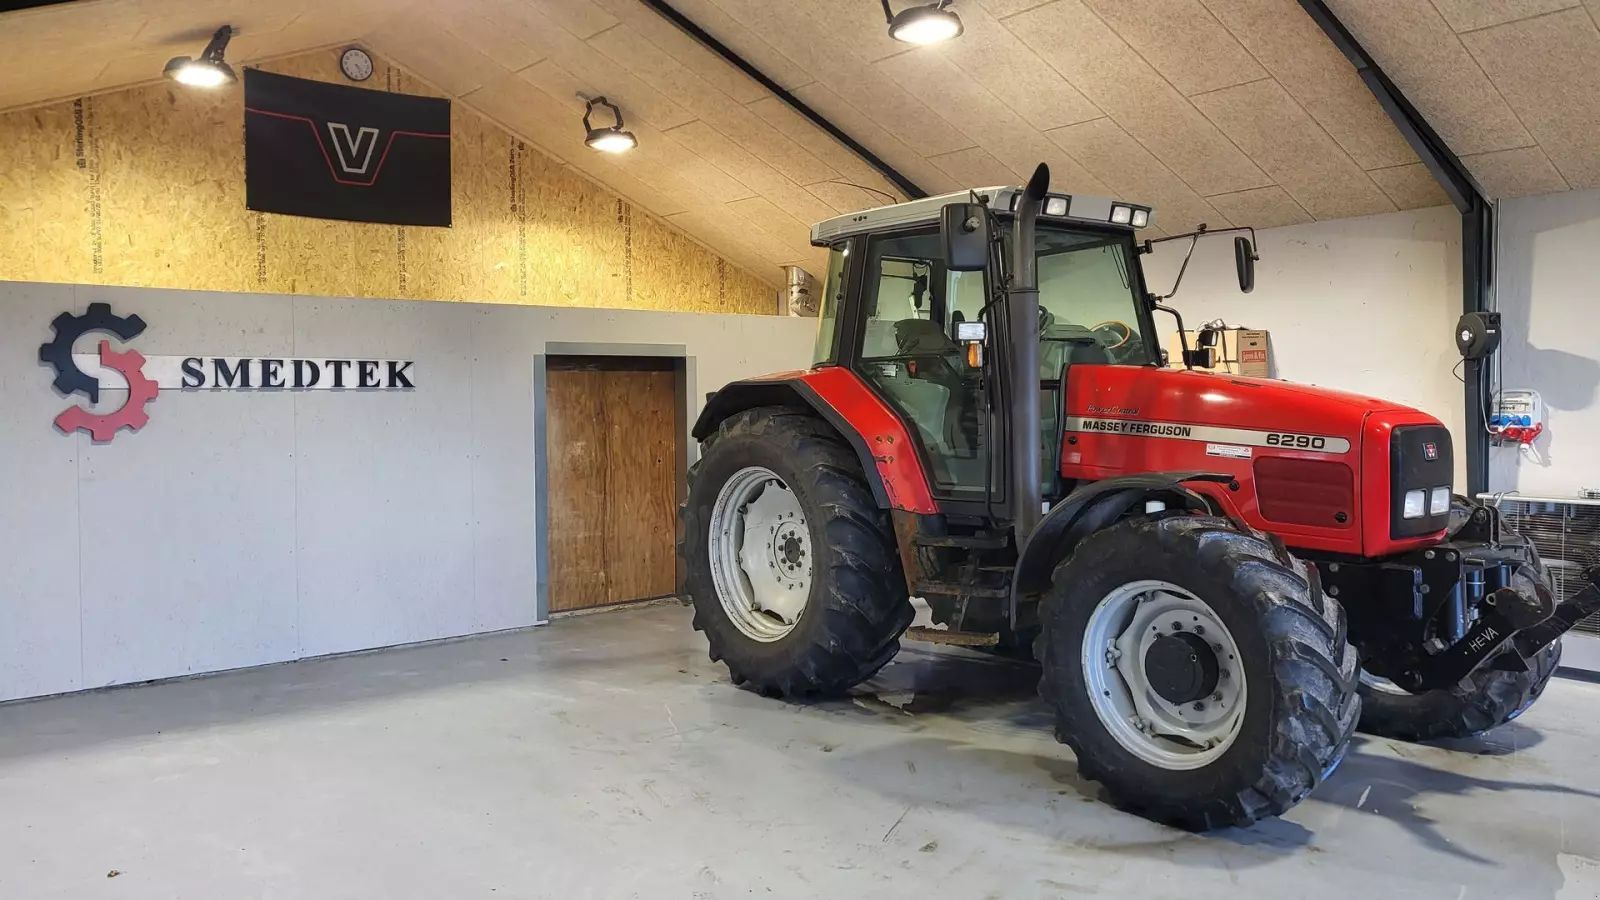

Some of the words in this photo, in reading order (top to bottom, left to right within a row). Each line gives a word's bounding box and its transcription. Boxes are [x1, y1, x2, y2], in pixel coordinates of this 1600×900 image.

[327, 122, 379, 174] V
[180, 357, 417, 389] SMEDTEK
[1082, 420, 1128, 433] MASSEY
[1129, 423, 1191, 437] FERGUSON
[1266, 433, 1326, 449] 6290
